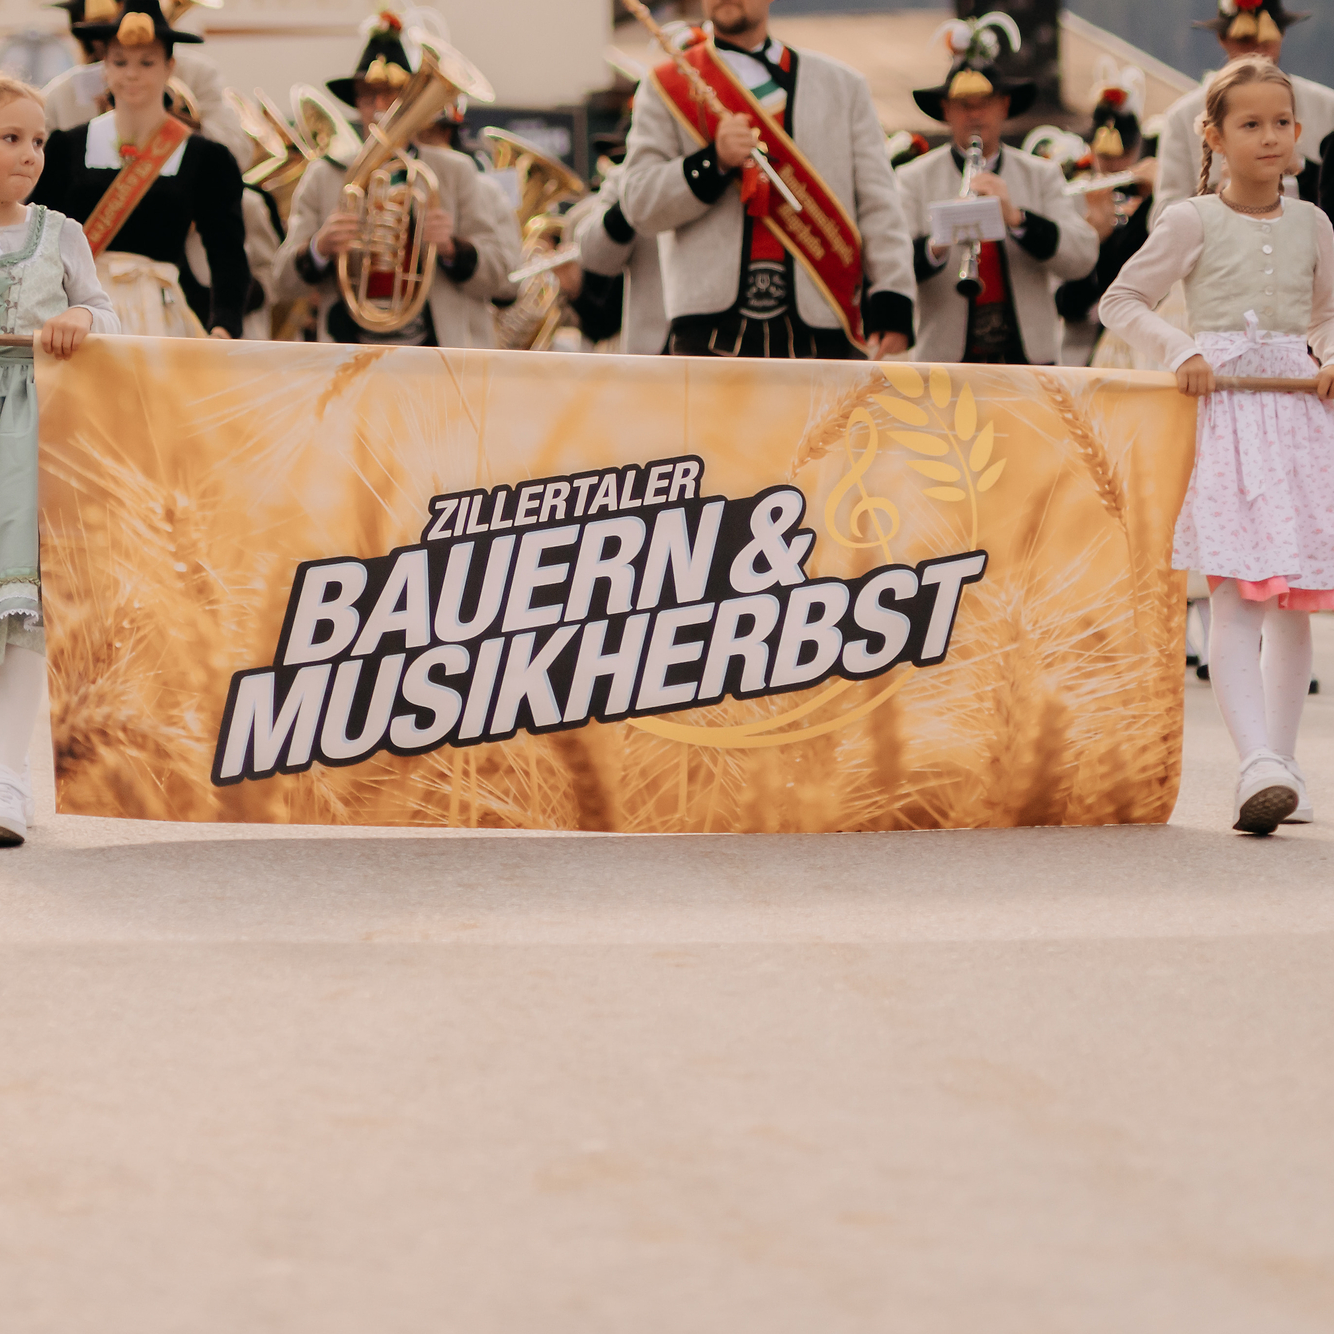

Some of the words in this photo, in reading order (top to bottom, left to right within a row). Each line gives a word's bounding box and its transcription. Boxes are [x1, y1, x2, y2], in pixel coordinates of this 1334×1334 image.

[284, 501, 724, 666] BAUERN
[731, 491, 813, 593] &
[427, 461, 700, 541] ZILLERTALER
[220, 555, 986, 778] MUSIKHERBST
